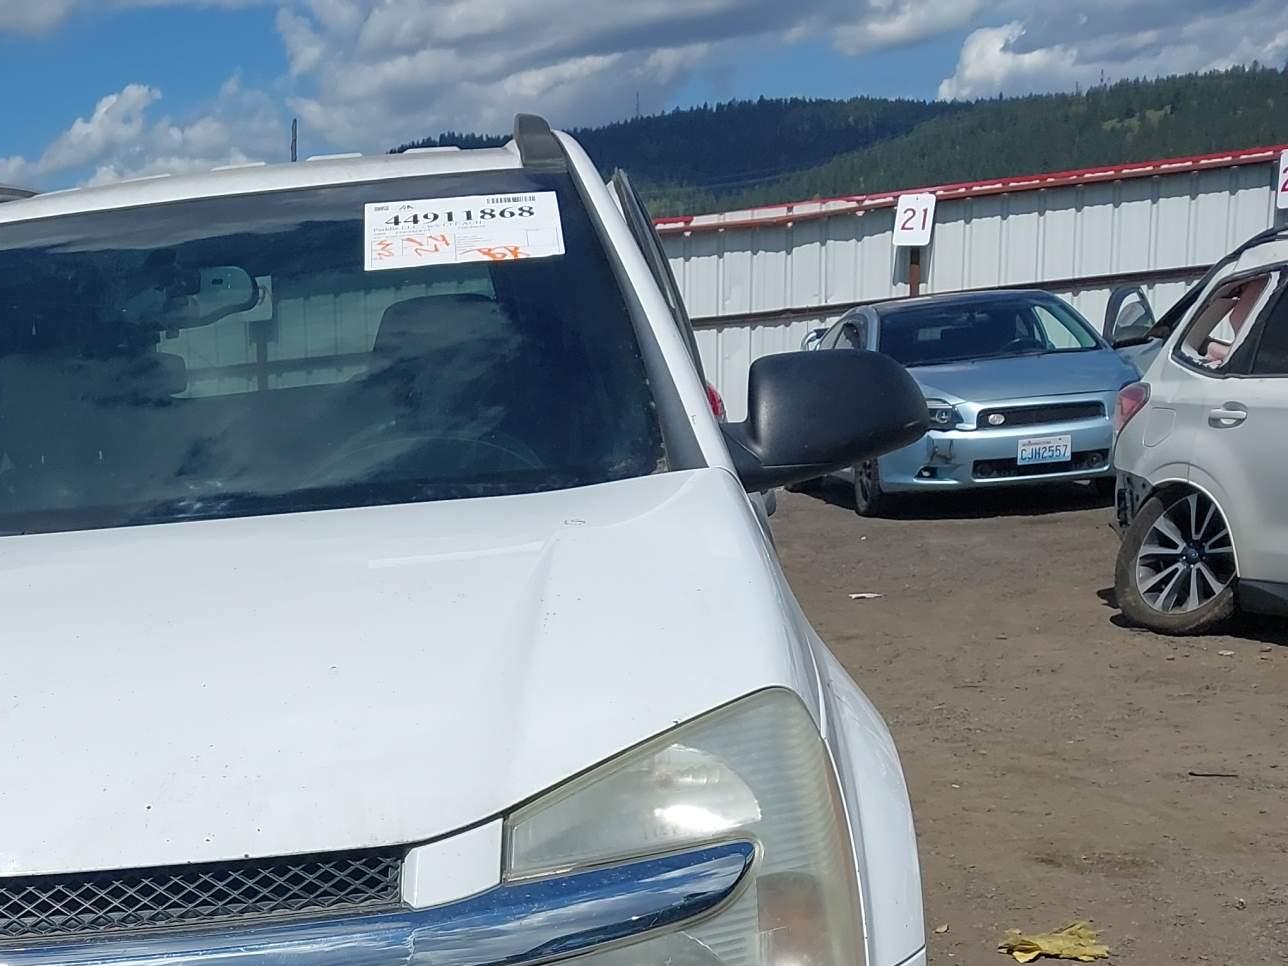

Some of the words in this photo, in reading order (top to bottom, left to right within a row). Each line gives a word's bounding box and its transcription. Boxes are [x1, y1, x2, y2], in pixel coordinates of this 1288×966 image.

[385, 205, 535, 226] 44911868
[900, 207, 929, 231] 21
[1020, 444, 1068, 461] CJH2557
